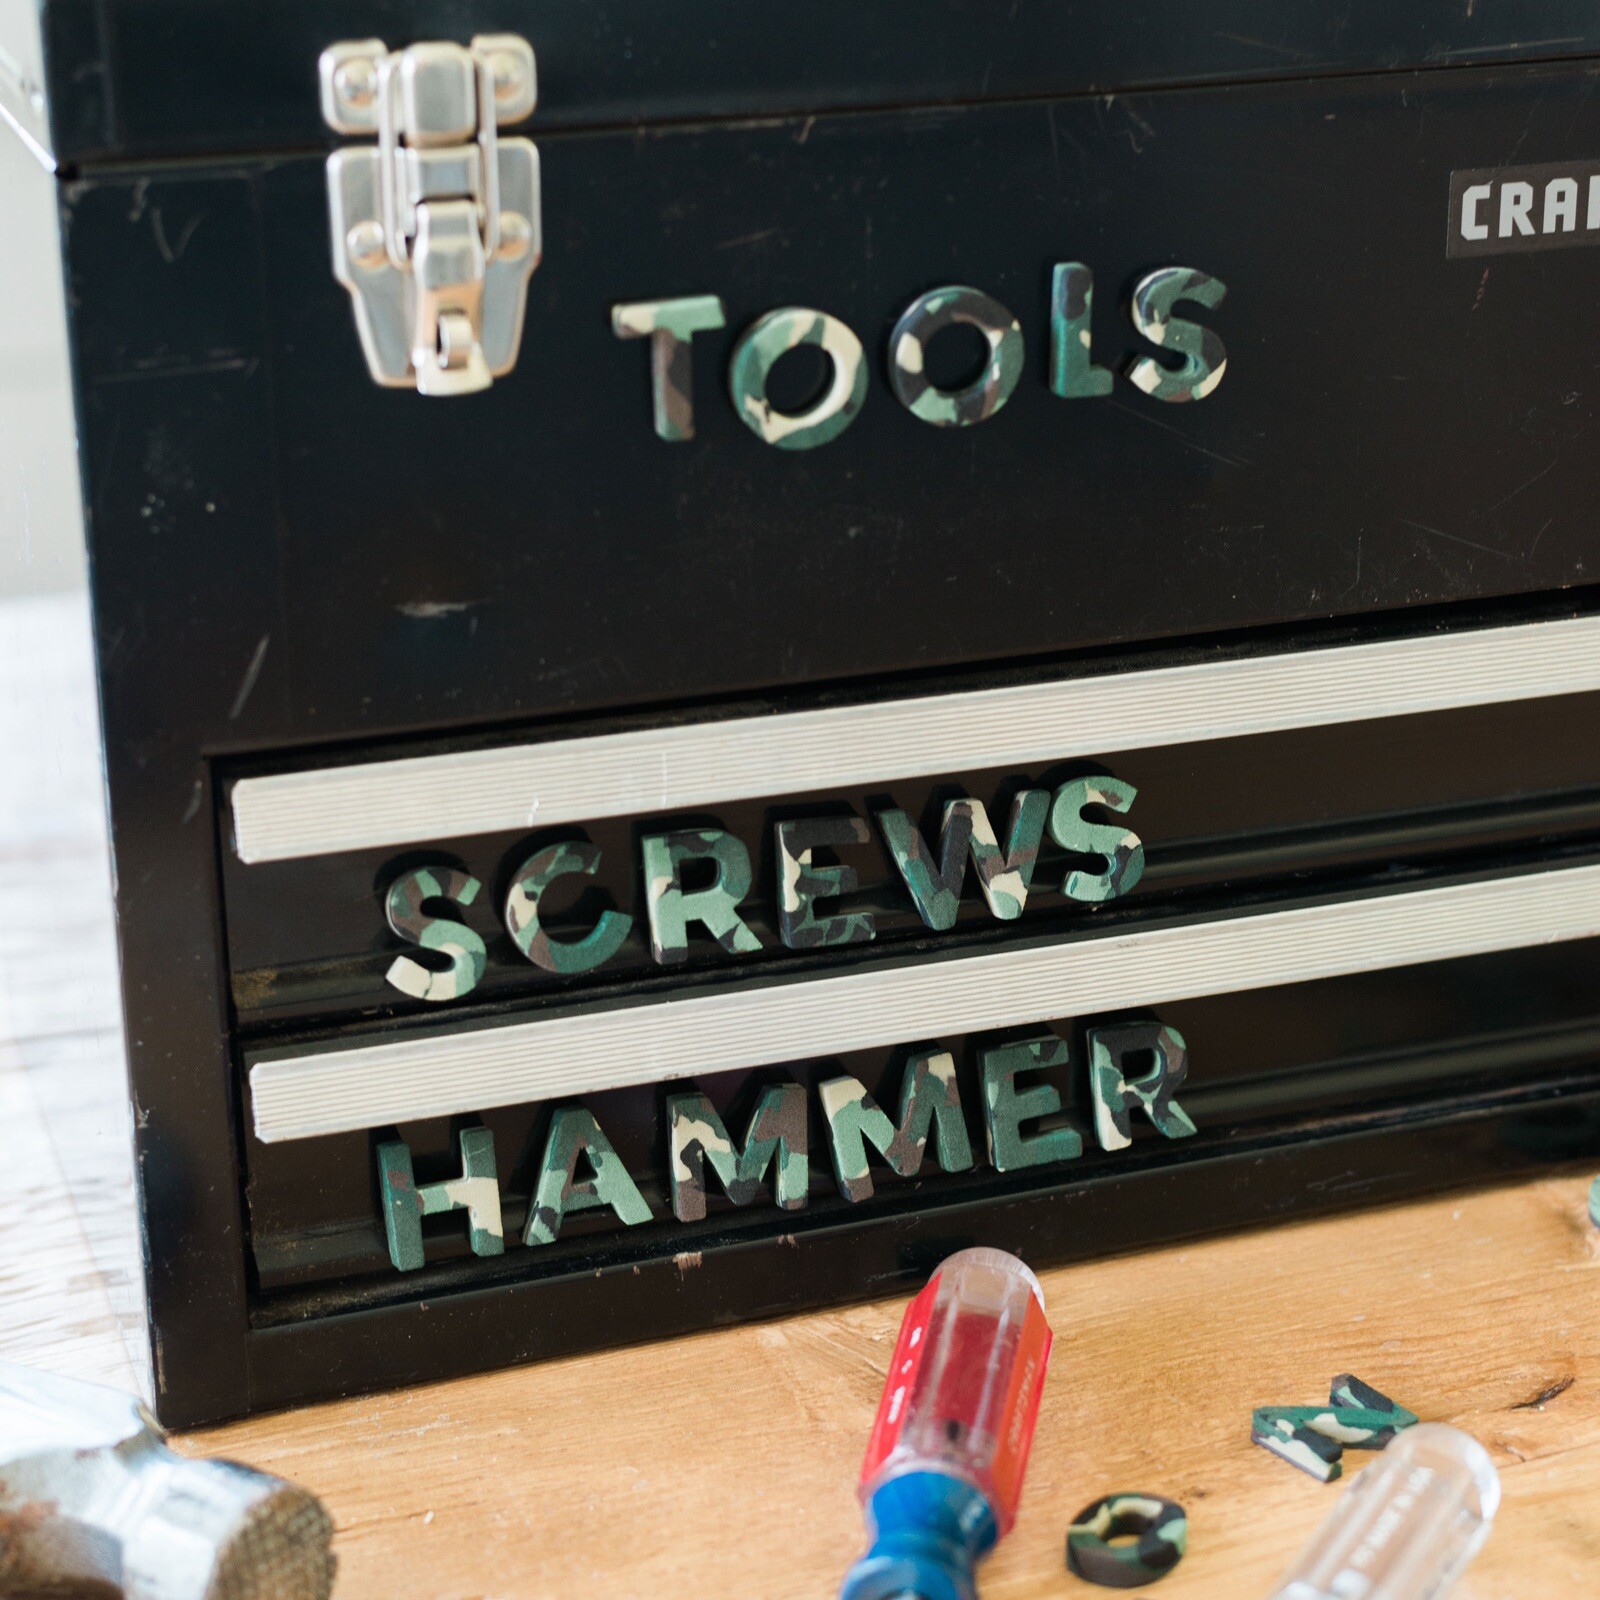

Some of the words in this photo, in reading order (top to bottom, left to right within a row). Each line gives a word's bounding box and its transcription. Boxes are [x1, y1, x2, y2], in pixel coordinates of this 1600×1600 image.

[611, 261, 1227, 450] TOOLS
[385, 775, 1145, 1001] SCREWS
[377, 1022, 1198, 1272] HAMMER
